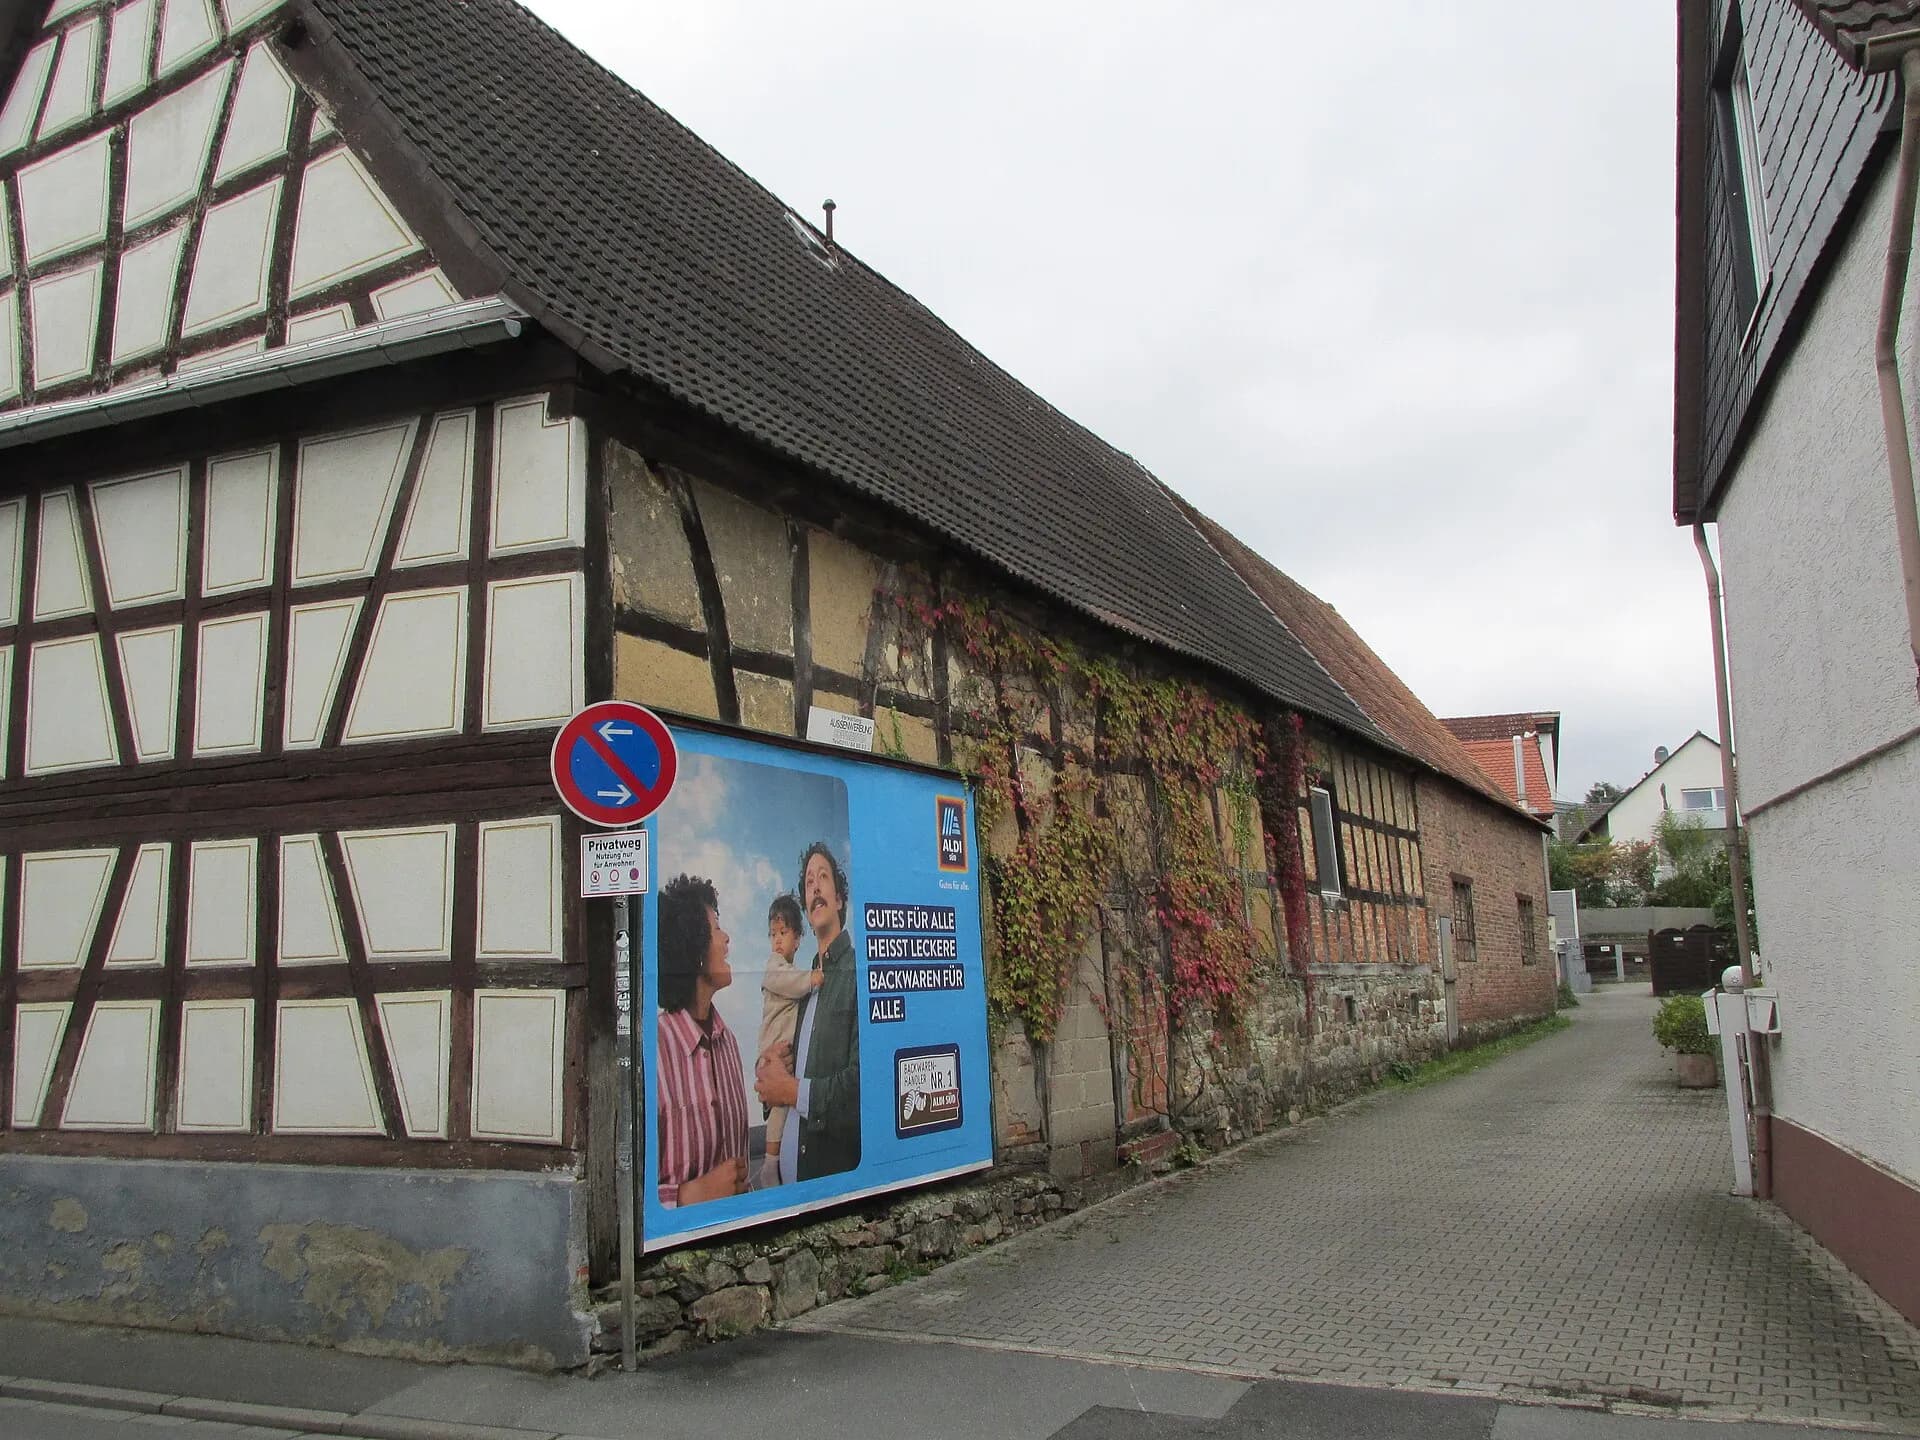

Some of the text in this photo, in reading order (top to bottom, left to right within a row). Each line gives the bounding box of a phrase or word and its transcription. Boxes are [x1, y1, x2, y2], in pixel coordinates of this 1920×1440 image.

[588, 839, 641, 851] Privatweg
[942, 838, 962, 854] ALDI
[596, 852, 621, 860] Nutzung
[604, 860, 636, 868] Anwohner
[866, 906, 955, 930] GUTES FÜR ALLE
[868, 938, 956, 958] HEISST LECKERE
[869, 964, 963, 990] BACKWAREN FÜR
[871, 999, 904, 1020] ALLE.
[930, 1071, 946, 1090] NR.
[947, 1070, 953, 1088] 1
[932, 1095, 945, 1107] ALDI
